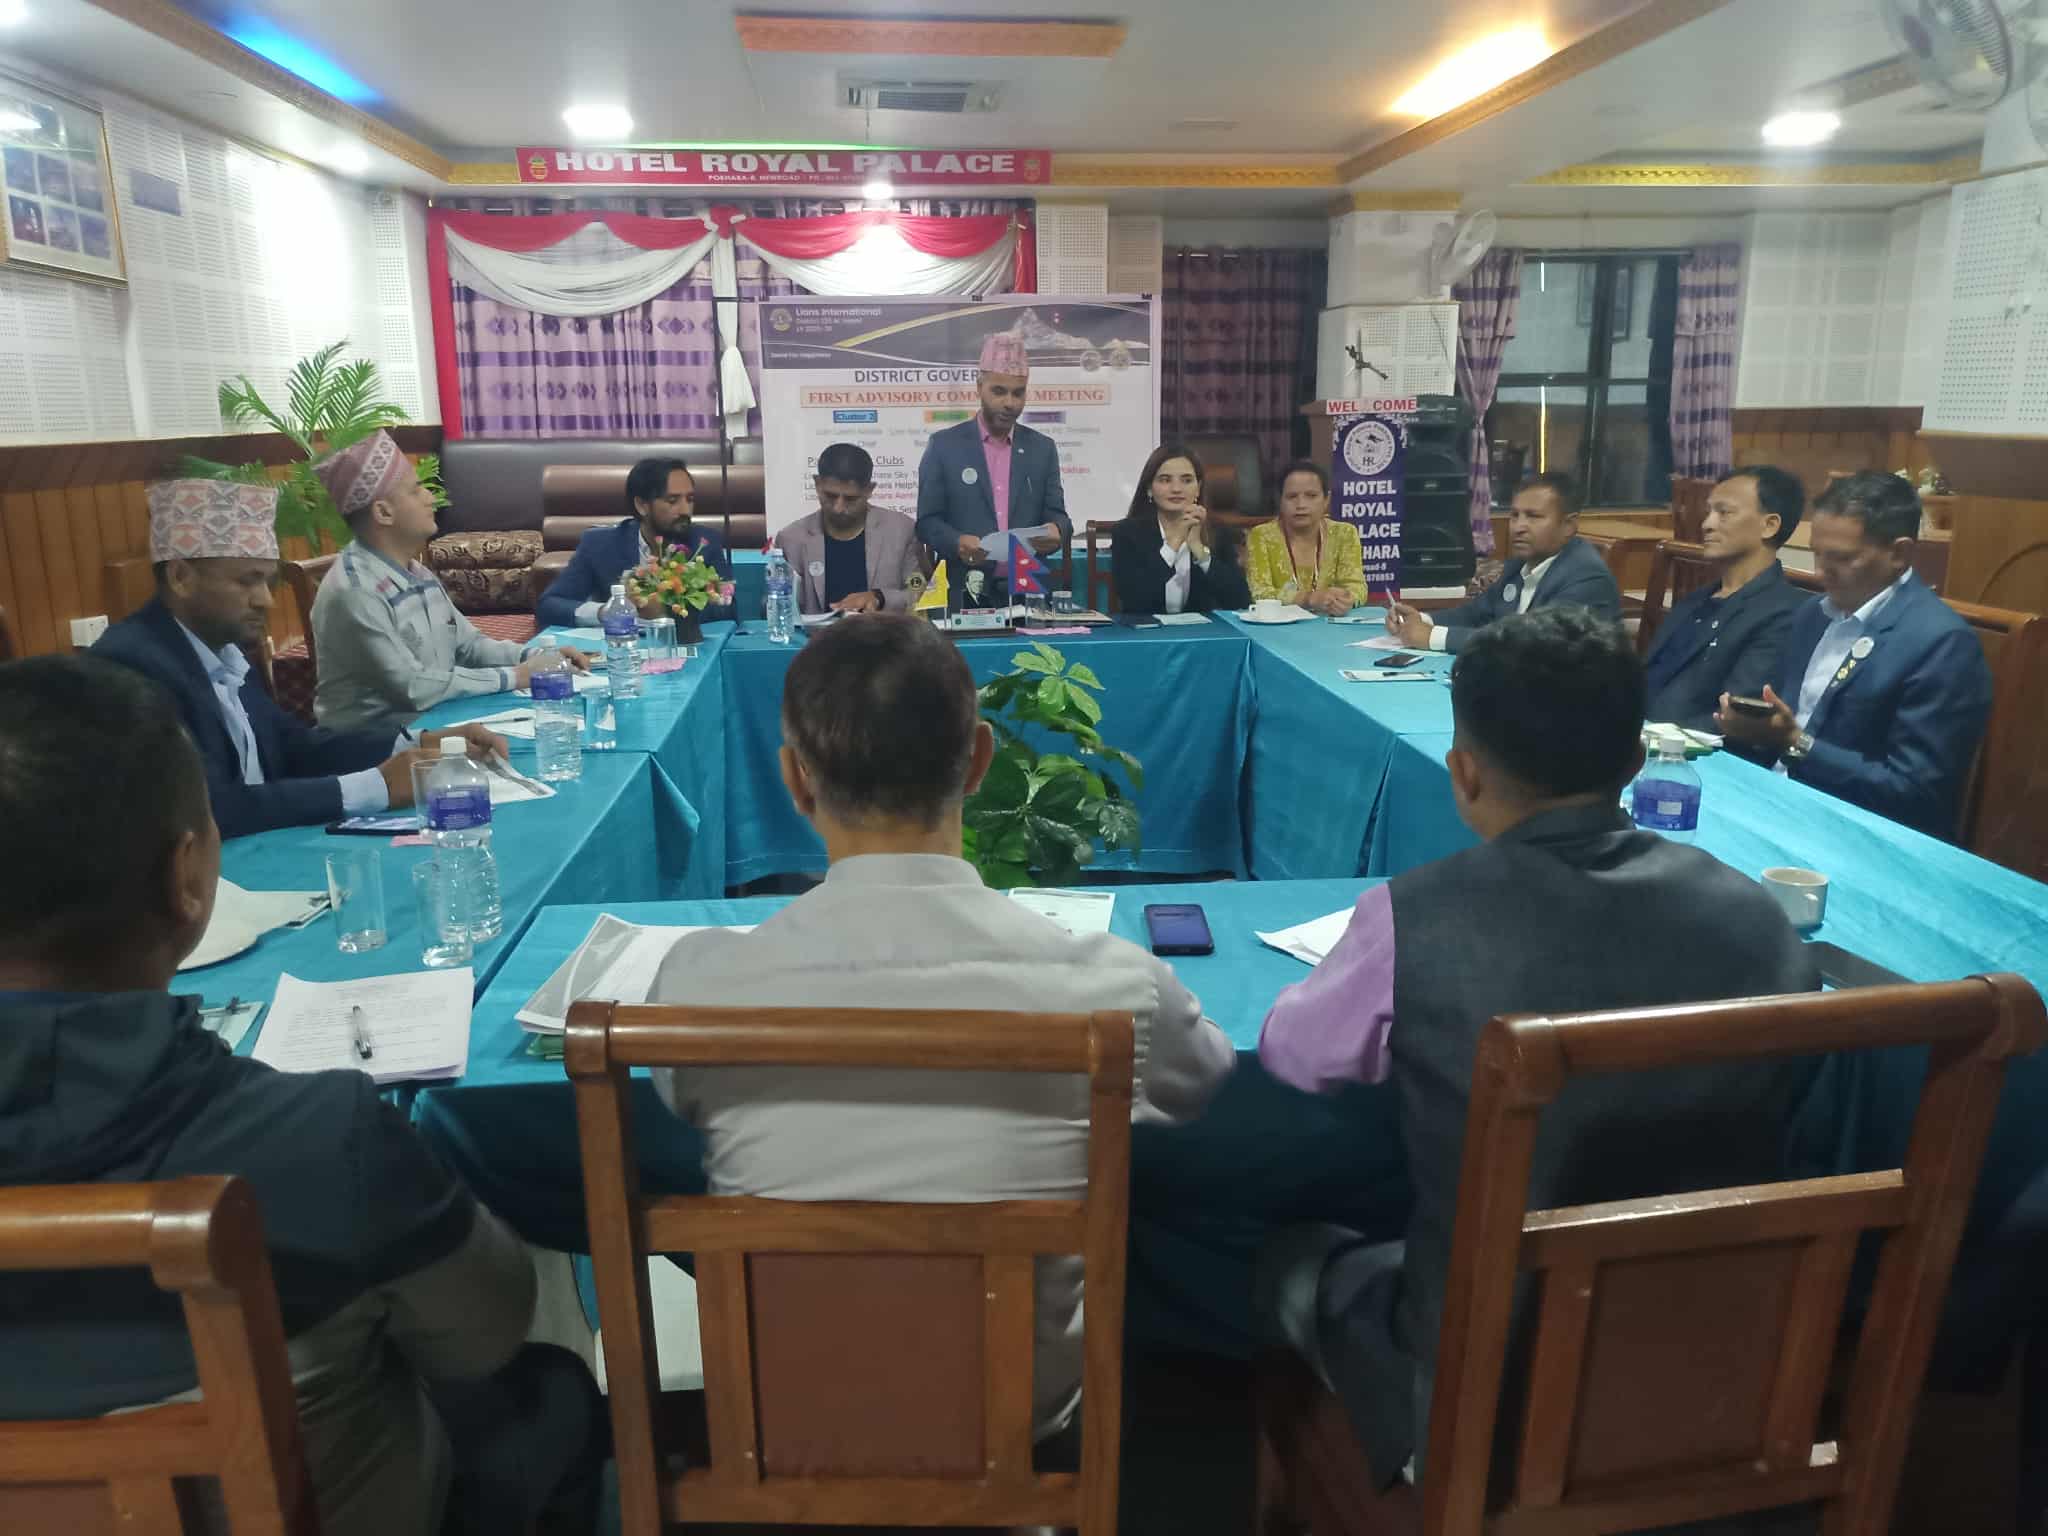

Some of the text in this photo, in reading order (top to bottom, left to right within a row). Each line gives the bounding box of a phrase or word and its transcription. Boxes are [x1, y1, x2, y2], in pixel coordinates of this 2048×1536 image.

[555, 151, 1015, 173] HOTEL ROYAL PALACE
[821, 308, 881, 316] International
[855, 369, 977, 383] DISTRICT GOVER
[808, 391, 850, 404] FIRST
[855, 391, 932, 403] ADVISORY
[1035, 389, 1104, 401] MEETING
[1328, 400, 1416, 412] WEL COME
[876, 456, 904, 464] Clubs
[1343, 480, 1397, 496] HOTEL
[1341, 502, 1396, 518] ROYAL
[1358, 523, 1401, 538] LACE
[1363, 545, 1400, 560] HARA
